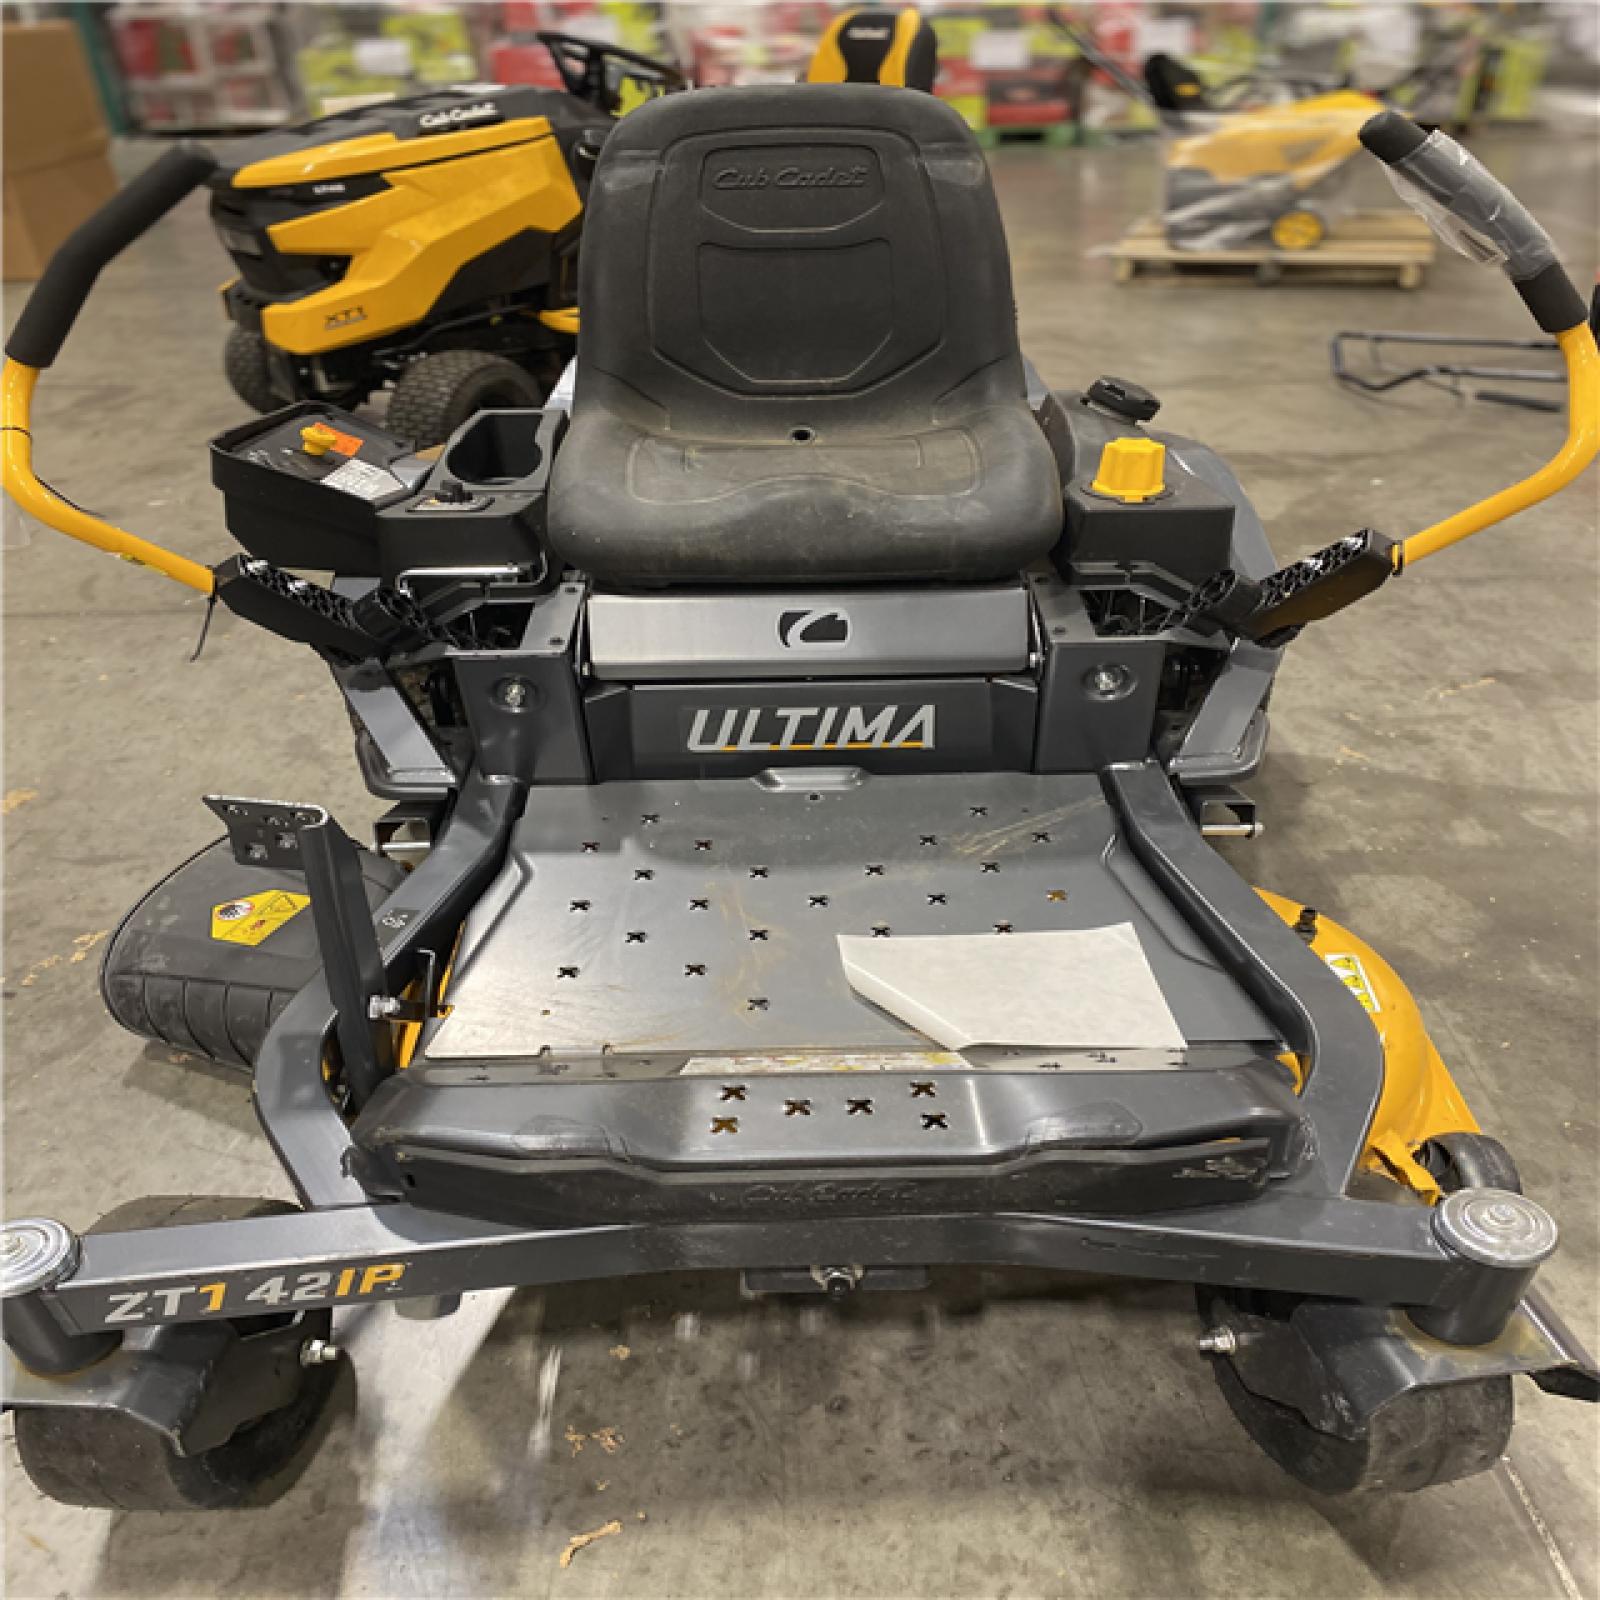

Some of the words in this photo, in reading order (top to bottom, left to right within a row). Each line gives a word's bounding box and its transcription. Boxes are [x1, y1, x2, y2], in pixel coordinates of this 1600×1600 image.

[714, 167, 770, 188] Cub
[774, 165, 868, 187] Cadet
[687, 704, 936, 753] ULTIMA
[104, 1282, 226, 1324] ZT1
